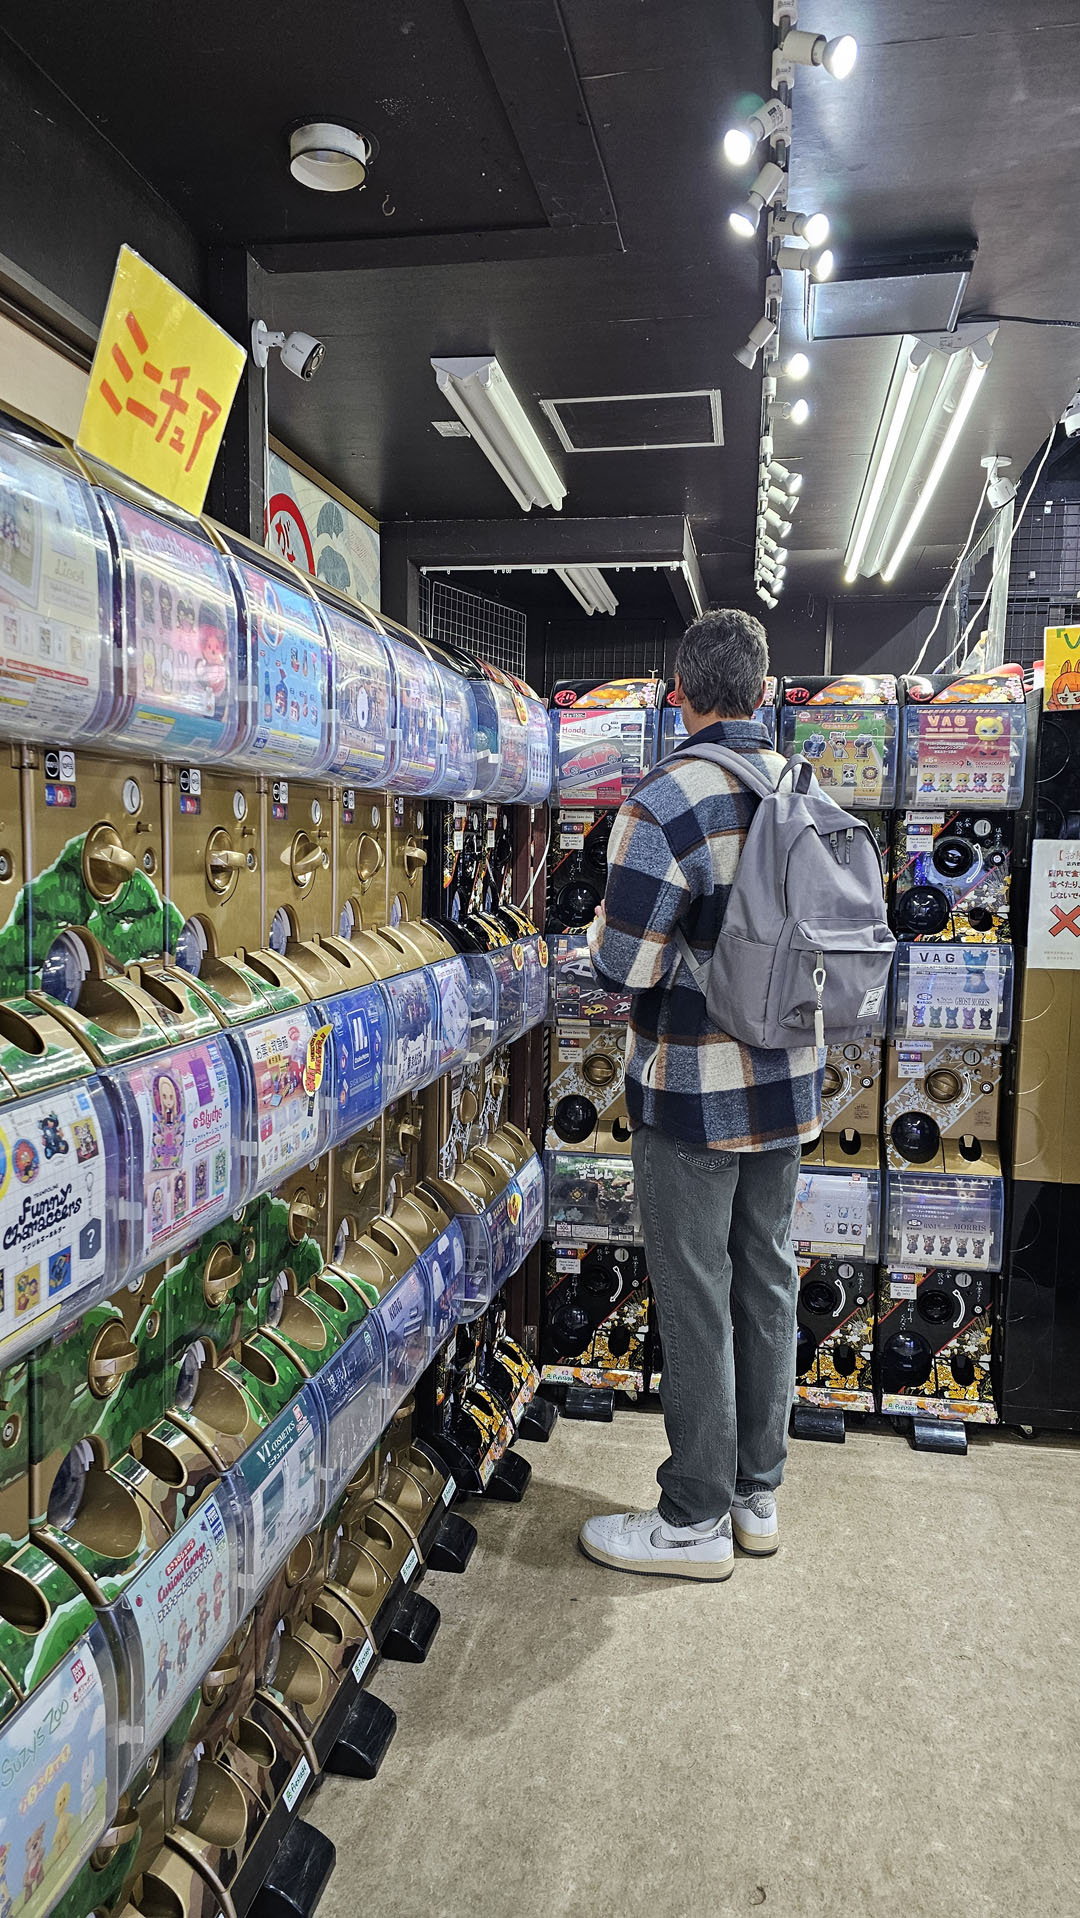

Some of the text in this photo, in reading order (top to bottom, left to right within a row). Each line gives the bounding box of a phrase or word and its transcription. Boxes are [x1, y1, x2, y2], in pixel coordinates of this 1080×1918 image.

[99, 311, 222, 472] ミニチュア
[927, 715, 966, 727] VAG
[919, 952, 955, 963] VAG
[579, 1168, 613, 1179] ゴーレム
[18, 1183, 72, 1225] Funny
[954, 1223, 987, 1231] MORRIS
[388, 1298, 403, 1321] KORG
[256, 1421, 296, 1463] VT COSMETICS
[157, 1543, 207, 1603] Curious George
